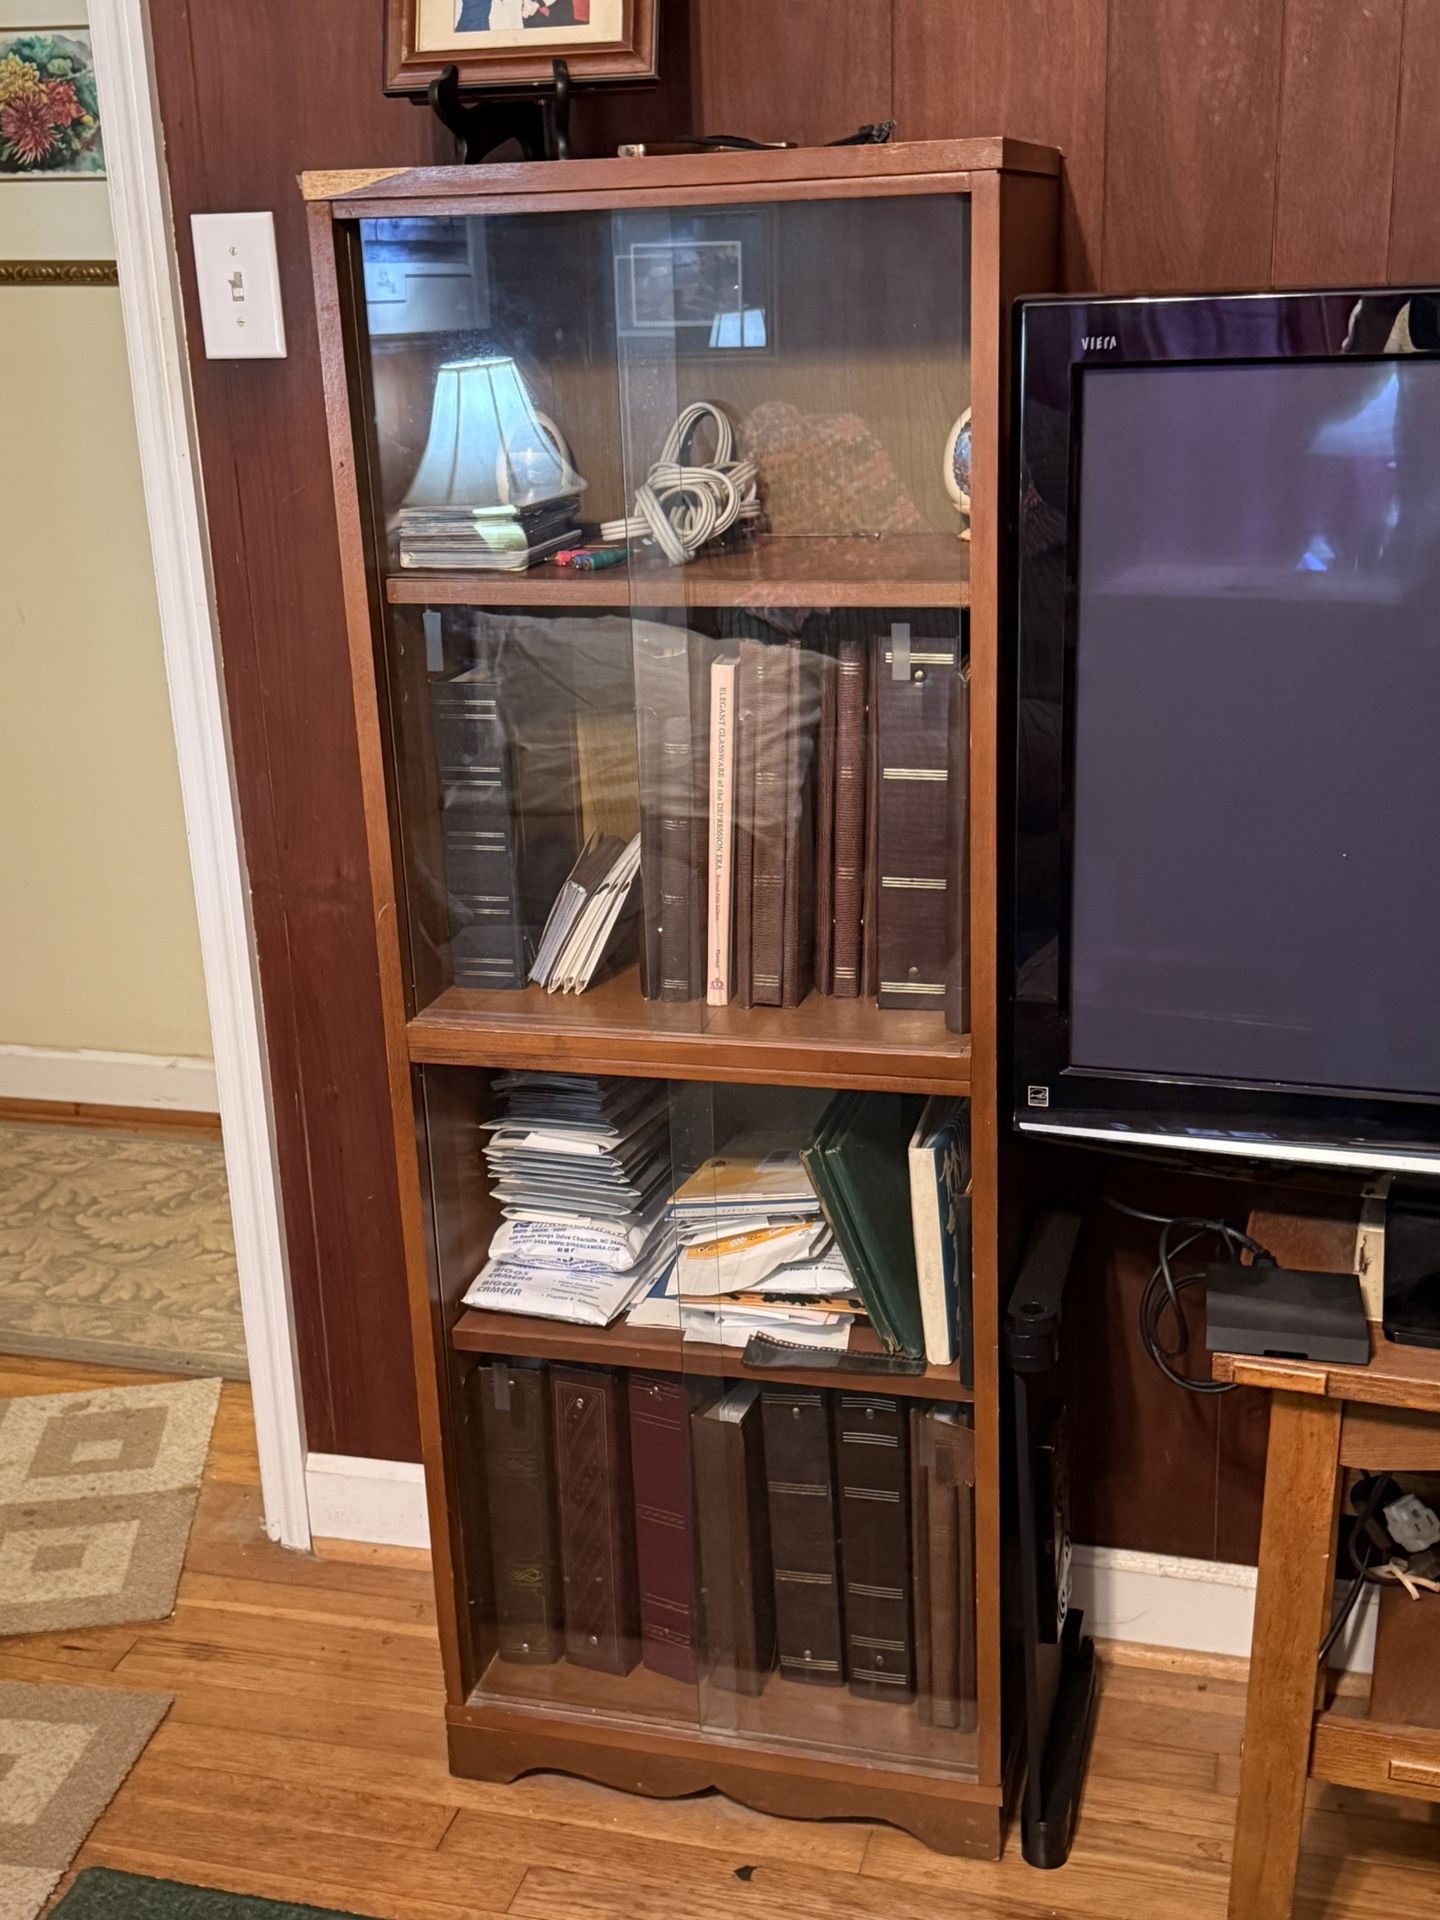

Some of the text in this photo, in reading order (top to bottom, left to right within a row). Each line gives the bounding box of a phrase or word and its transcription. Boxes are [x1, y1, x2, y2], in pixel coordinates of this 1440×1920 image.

[1081, 336, 1117, 350] VIERA
[715, 686, 727, 870] ELEGANT GLASSWARE of the DEPRESSION ERA
[487, 1273, 534, 1281] CAMERA
[476, 1286, 523, 1296] CAMERA
